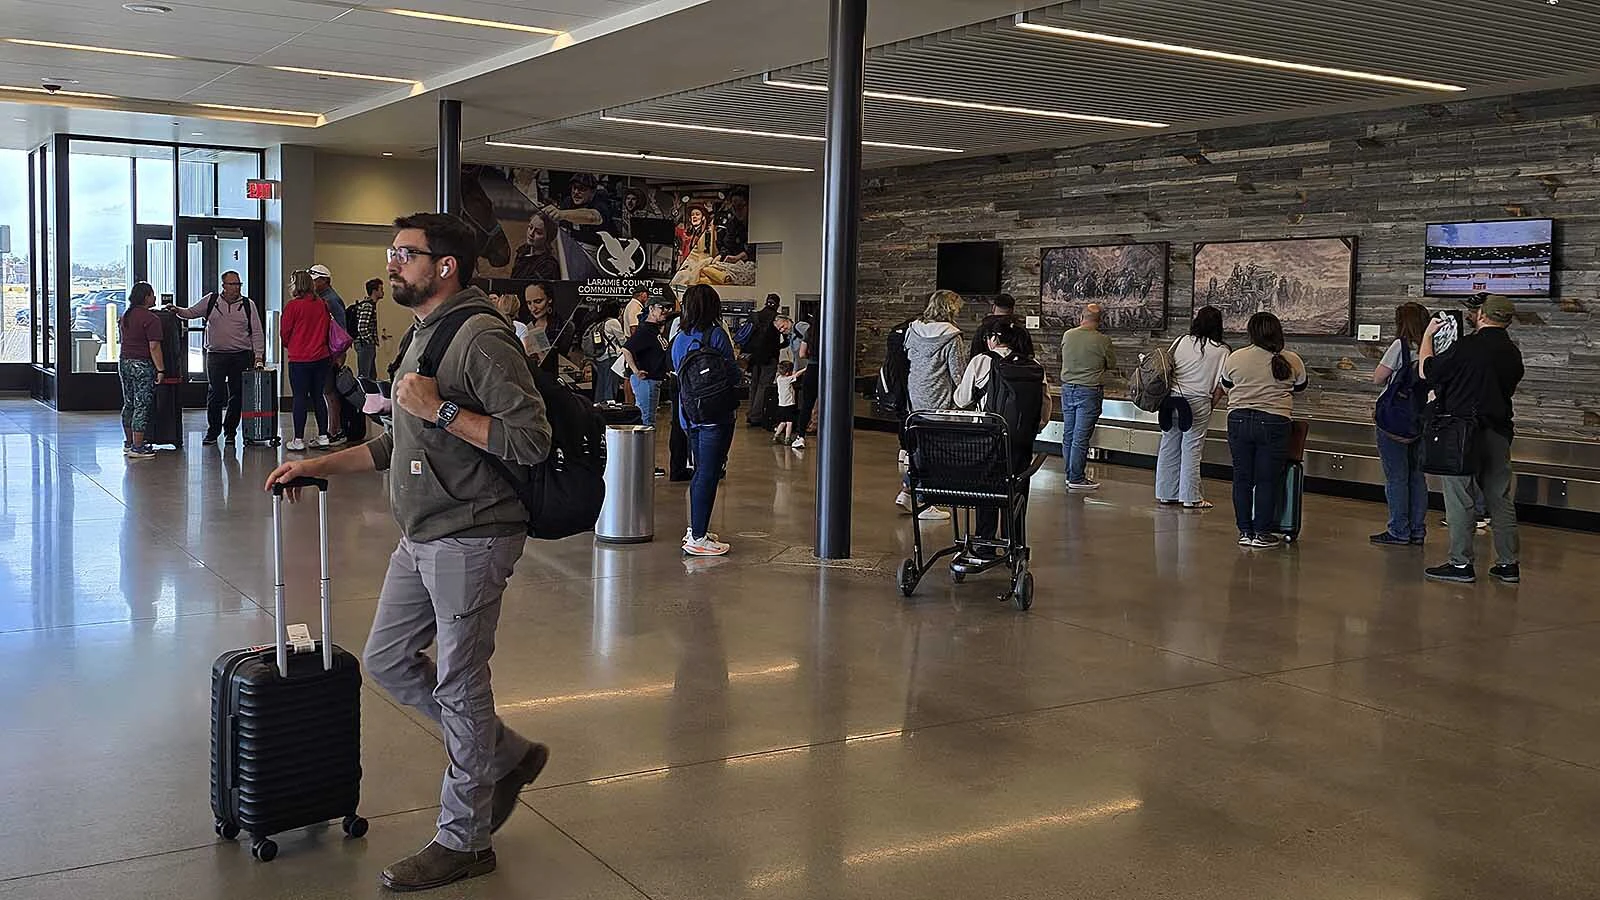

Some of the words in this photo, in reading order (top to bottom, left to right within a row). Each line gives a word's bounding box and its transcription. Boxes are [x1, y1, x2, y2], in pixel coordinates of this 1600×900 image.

[587, 278, 620, 286] LARAMIE
[622, 279, 654, 287] COUNTY
[578, 285, 628, 294] COMMUNITY
[628, 287, 663, 295] CEGE
